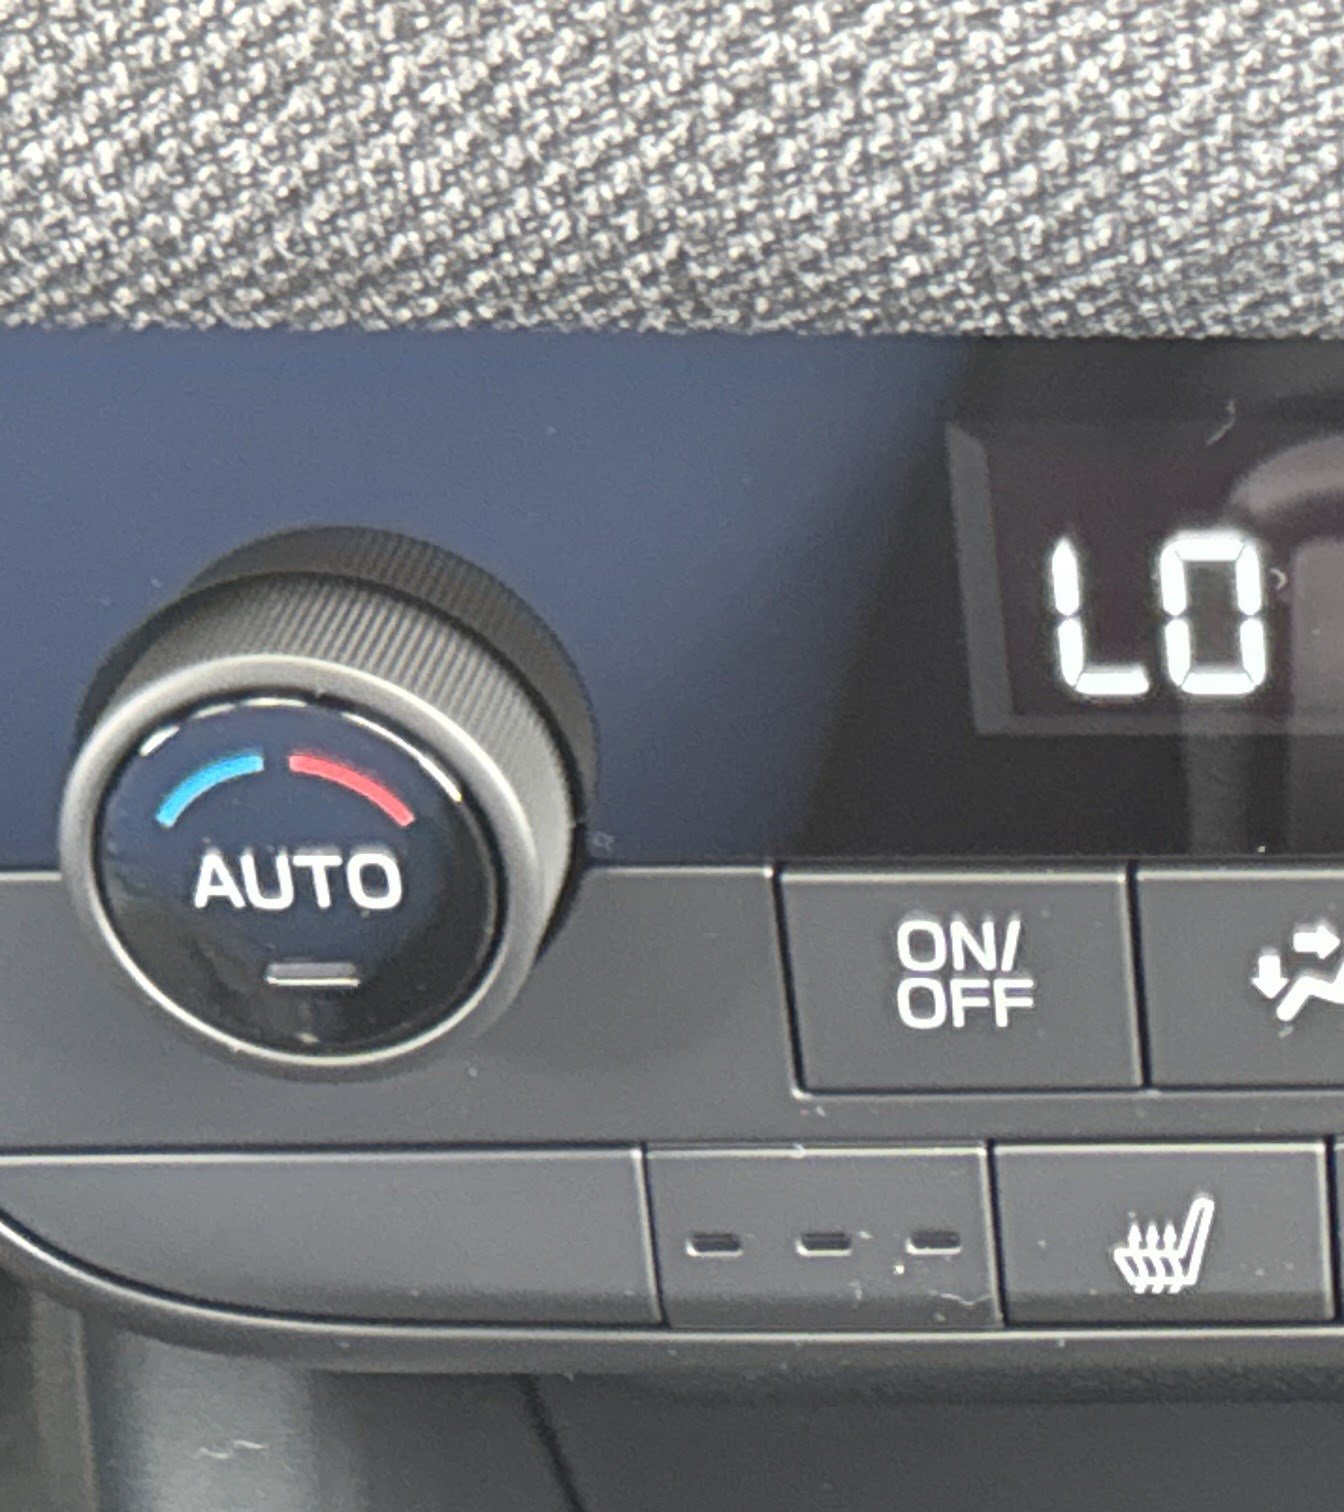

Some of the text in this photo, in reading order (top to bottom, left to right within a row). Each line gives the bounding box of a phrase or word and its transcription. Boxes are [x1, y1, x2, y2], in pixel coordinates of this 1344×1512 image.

[1050, 528, 1270, 698] LO
[192, 846, 404, 912] AUTO
[896, 912, 1022, 974] ON/
[896, 976, 1036, 1031] OFF
